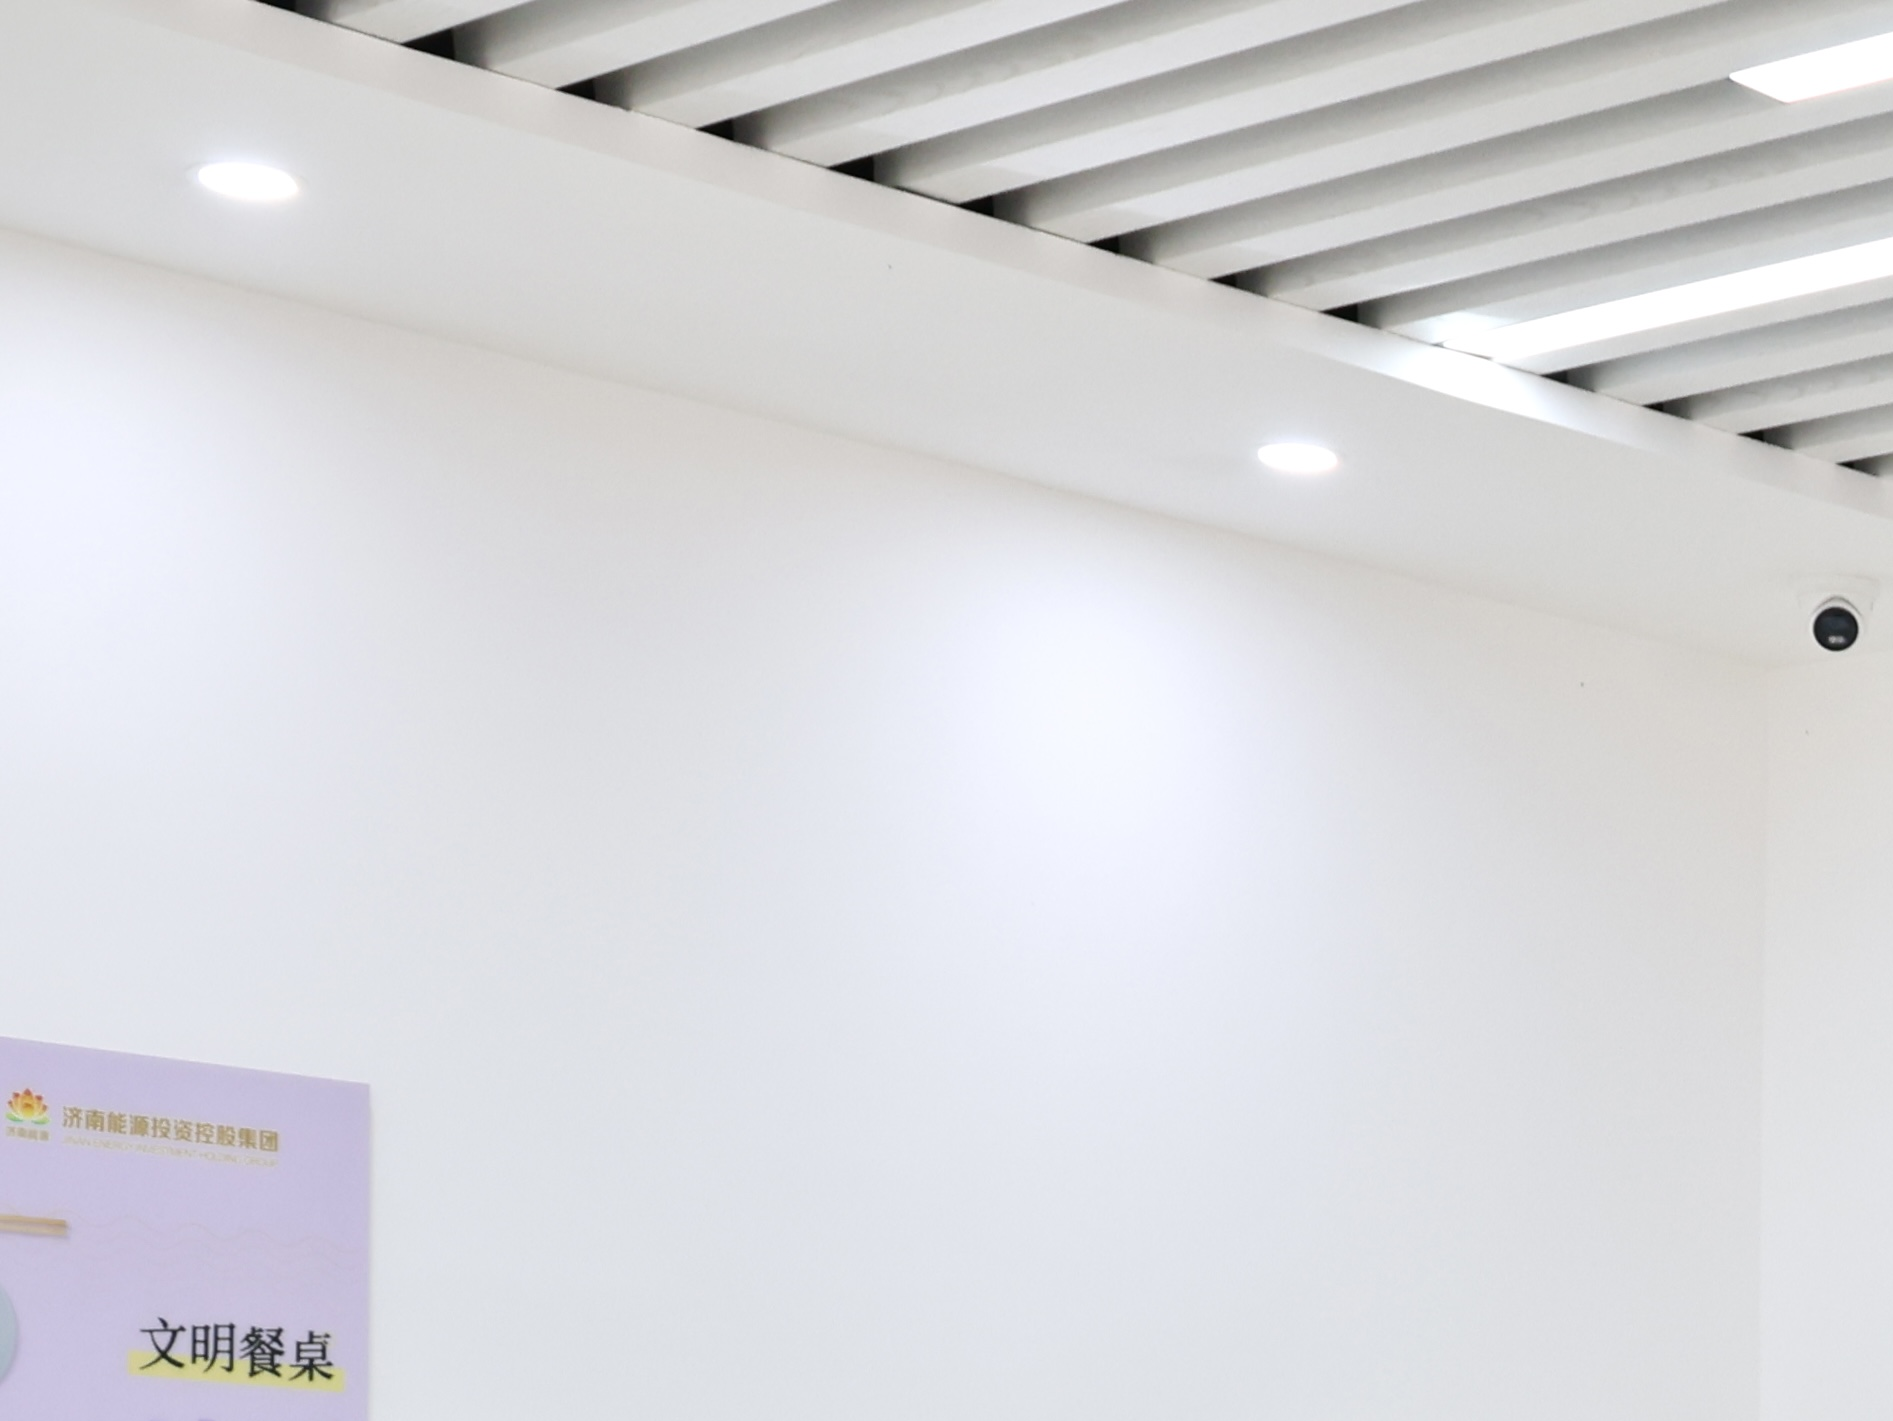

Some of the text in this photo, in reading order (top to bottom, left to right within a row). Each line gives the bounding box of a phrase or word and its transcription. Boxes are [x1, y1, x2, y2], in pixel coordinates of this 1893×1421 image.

[62, 1106, 279, 1152] 济南能源投资控股集团
[139, 1317, 335, 1382] 文明餐桌
